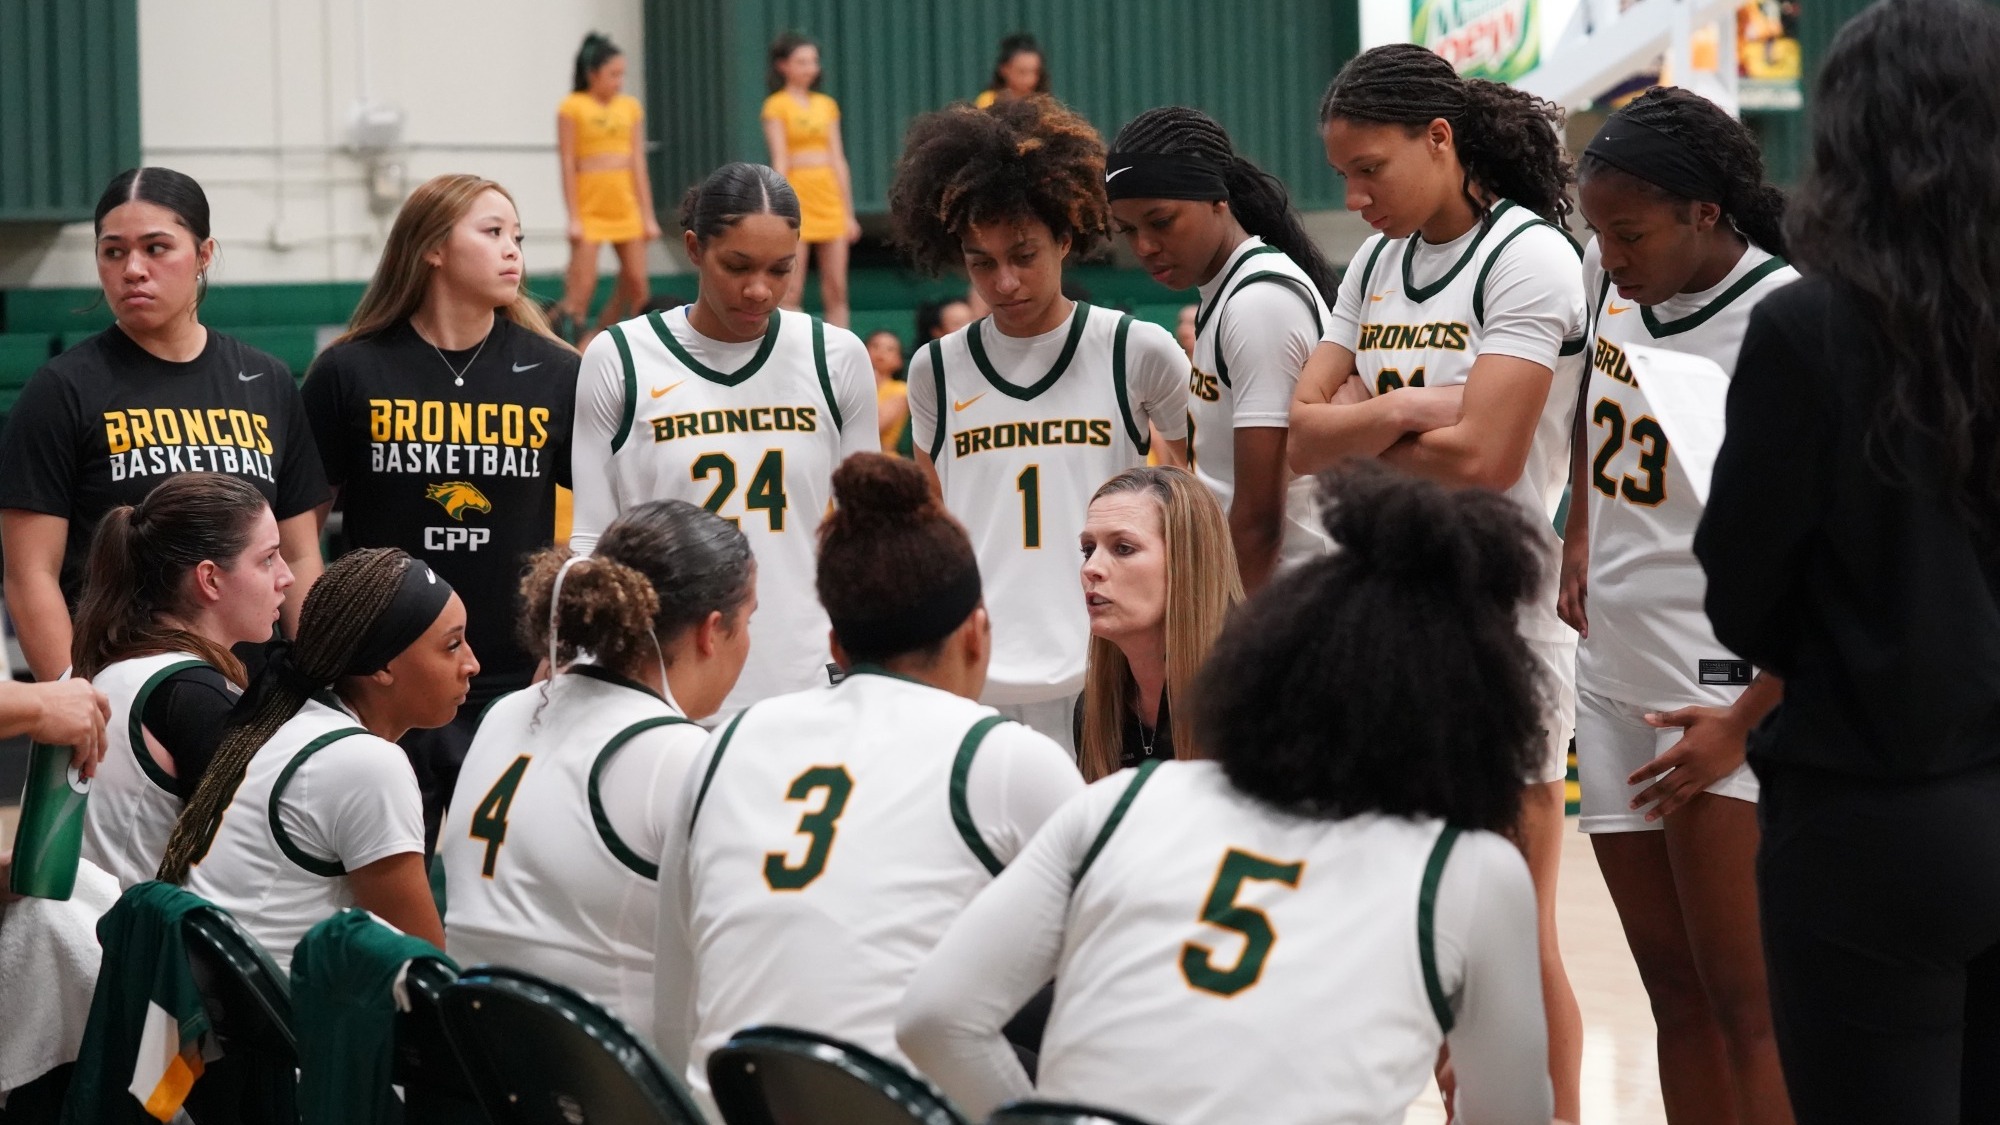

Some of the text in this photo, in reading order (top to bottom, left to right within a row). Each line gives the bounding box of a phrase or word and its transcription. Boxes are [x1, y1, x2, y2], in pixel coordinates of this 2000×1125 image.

[1594, 336, 1640, 389] BRO
[103, 408, 274, 455] BRONCOS
[369, 399, 550, 449] BRONCOS
[652, 406, 817, 443] BRONCOS
[953, 419, 1112, 459] BRONCOS
[109, 445, 275, 484] BASKETBALL
[370, 443, 541, 477] BASKETBALL
[1593, 397, 1671, 508] 23
[690, 448, 788, 532] 24
[1016, 463, 1042, 550] 1
[424, 526, 491, 552] CPP
[1737, 667, 1743, 678] L
[468, 753, 534, 880] 4
[762, 774, 856, 893] 3
[1178, 846, 1306, 1000] 5
